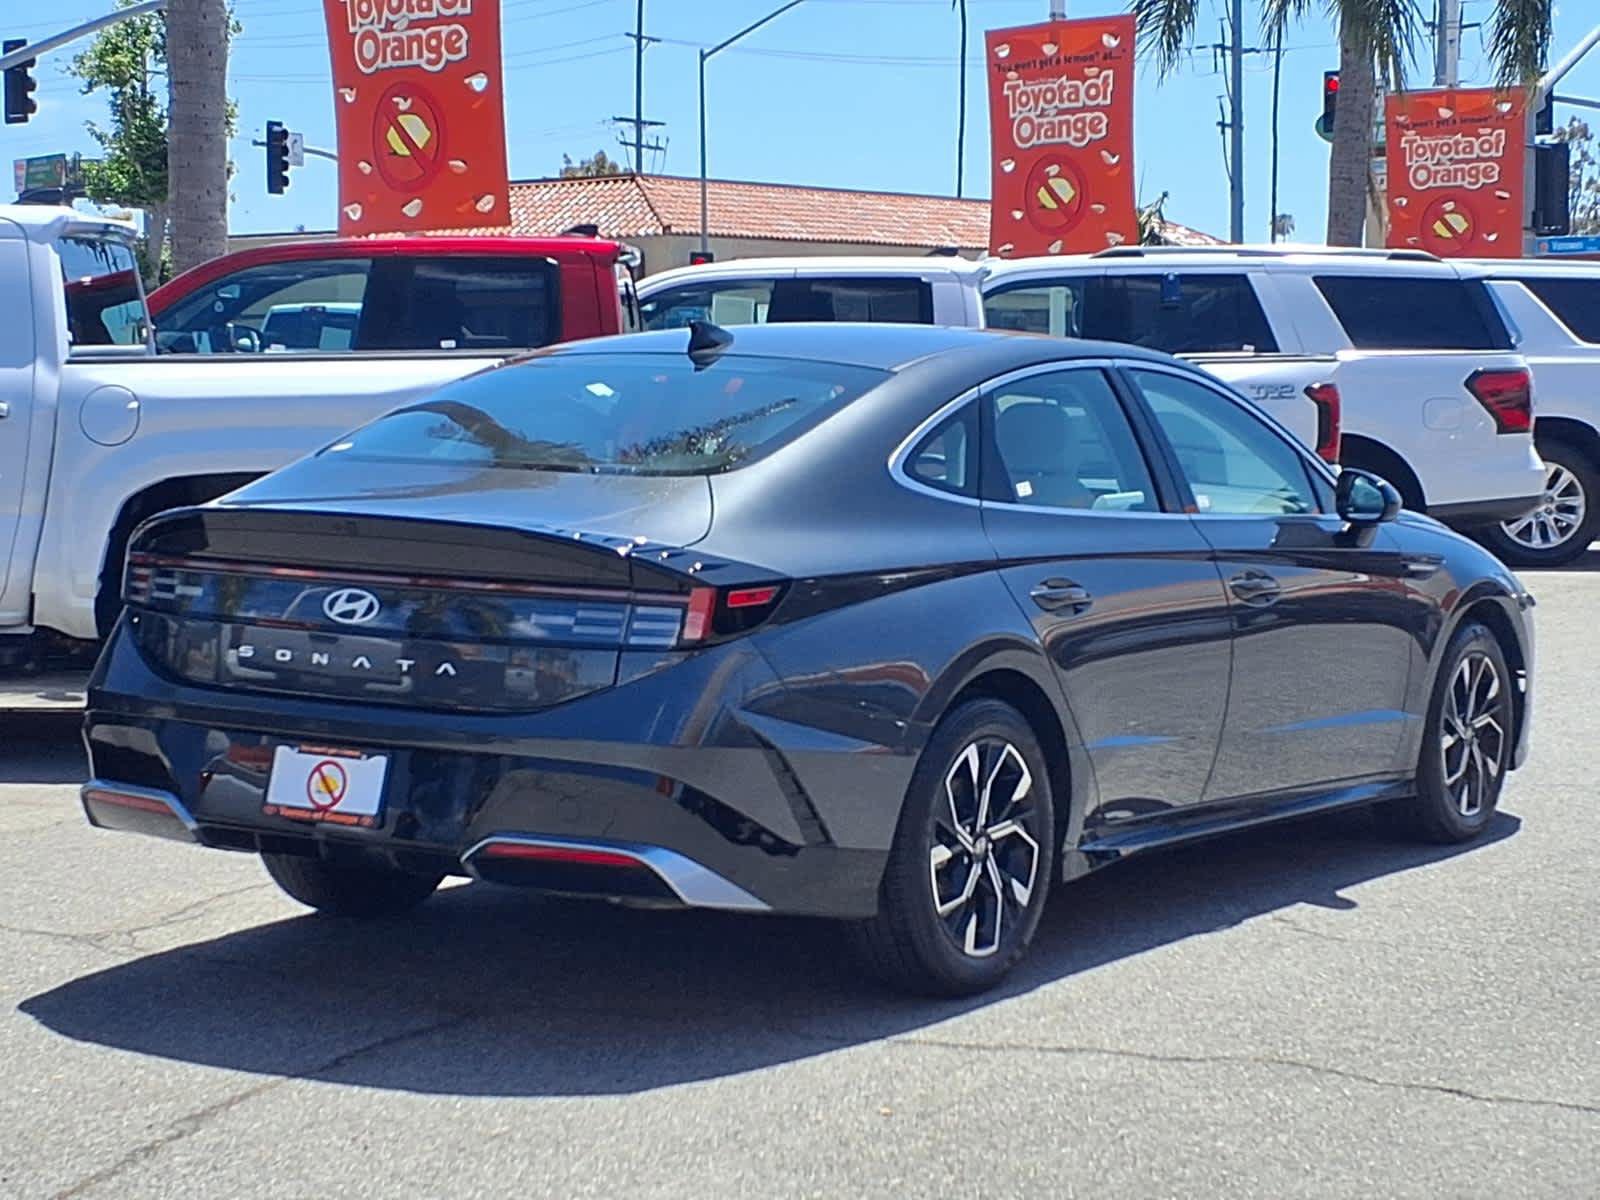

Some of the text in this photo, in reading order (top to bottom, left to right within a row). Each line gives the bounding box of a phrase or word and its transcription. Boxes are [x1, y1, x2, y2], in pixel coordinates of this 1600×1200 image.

[355, 24, 468, 73] Orange
[1004, 69, 1113, 118] Toyota of
[1013, 112, 1107, 148] Orange
[1401, 129, 1505, 167] Toyota of
[1409, 162, 1499, 190] Orange
[238, 645, 457, 676] SONATA
